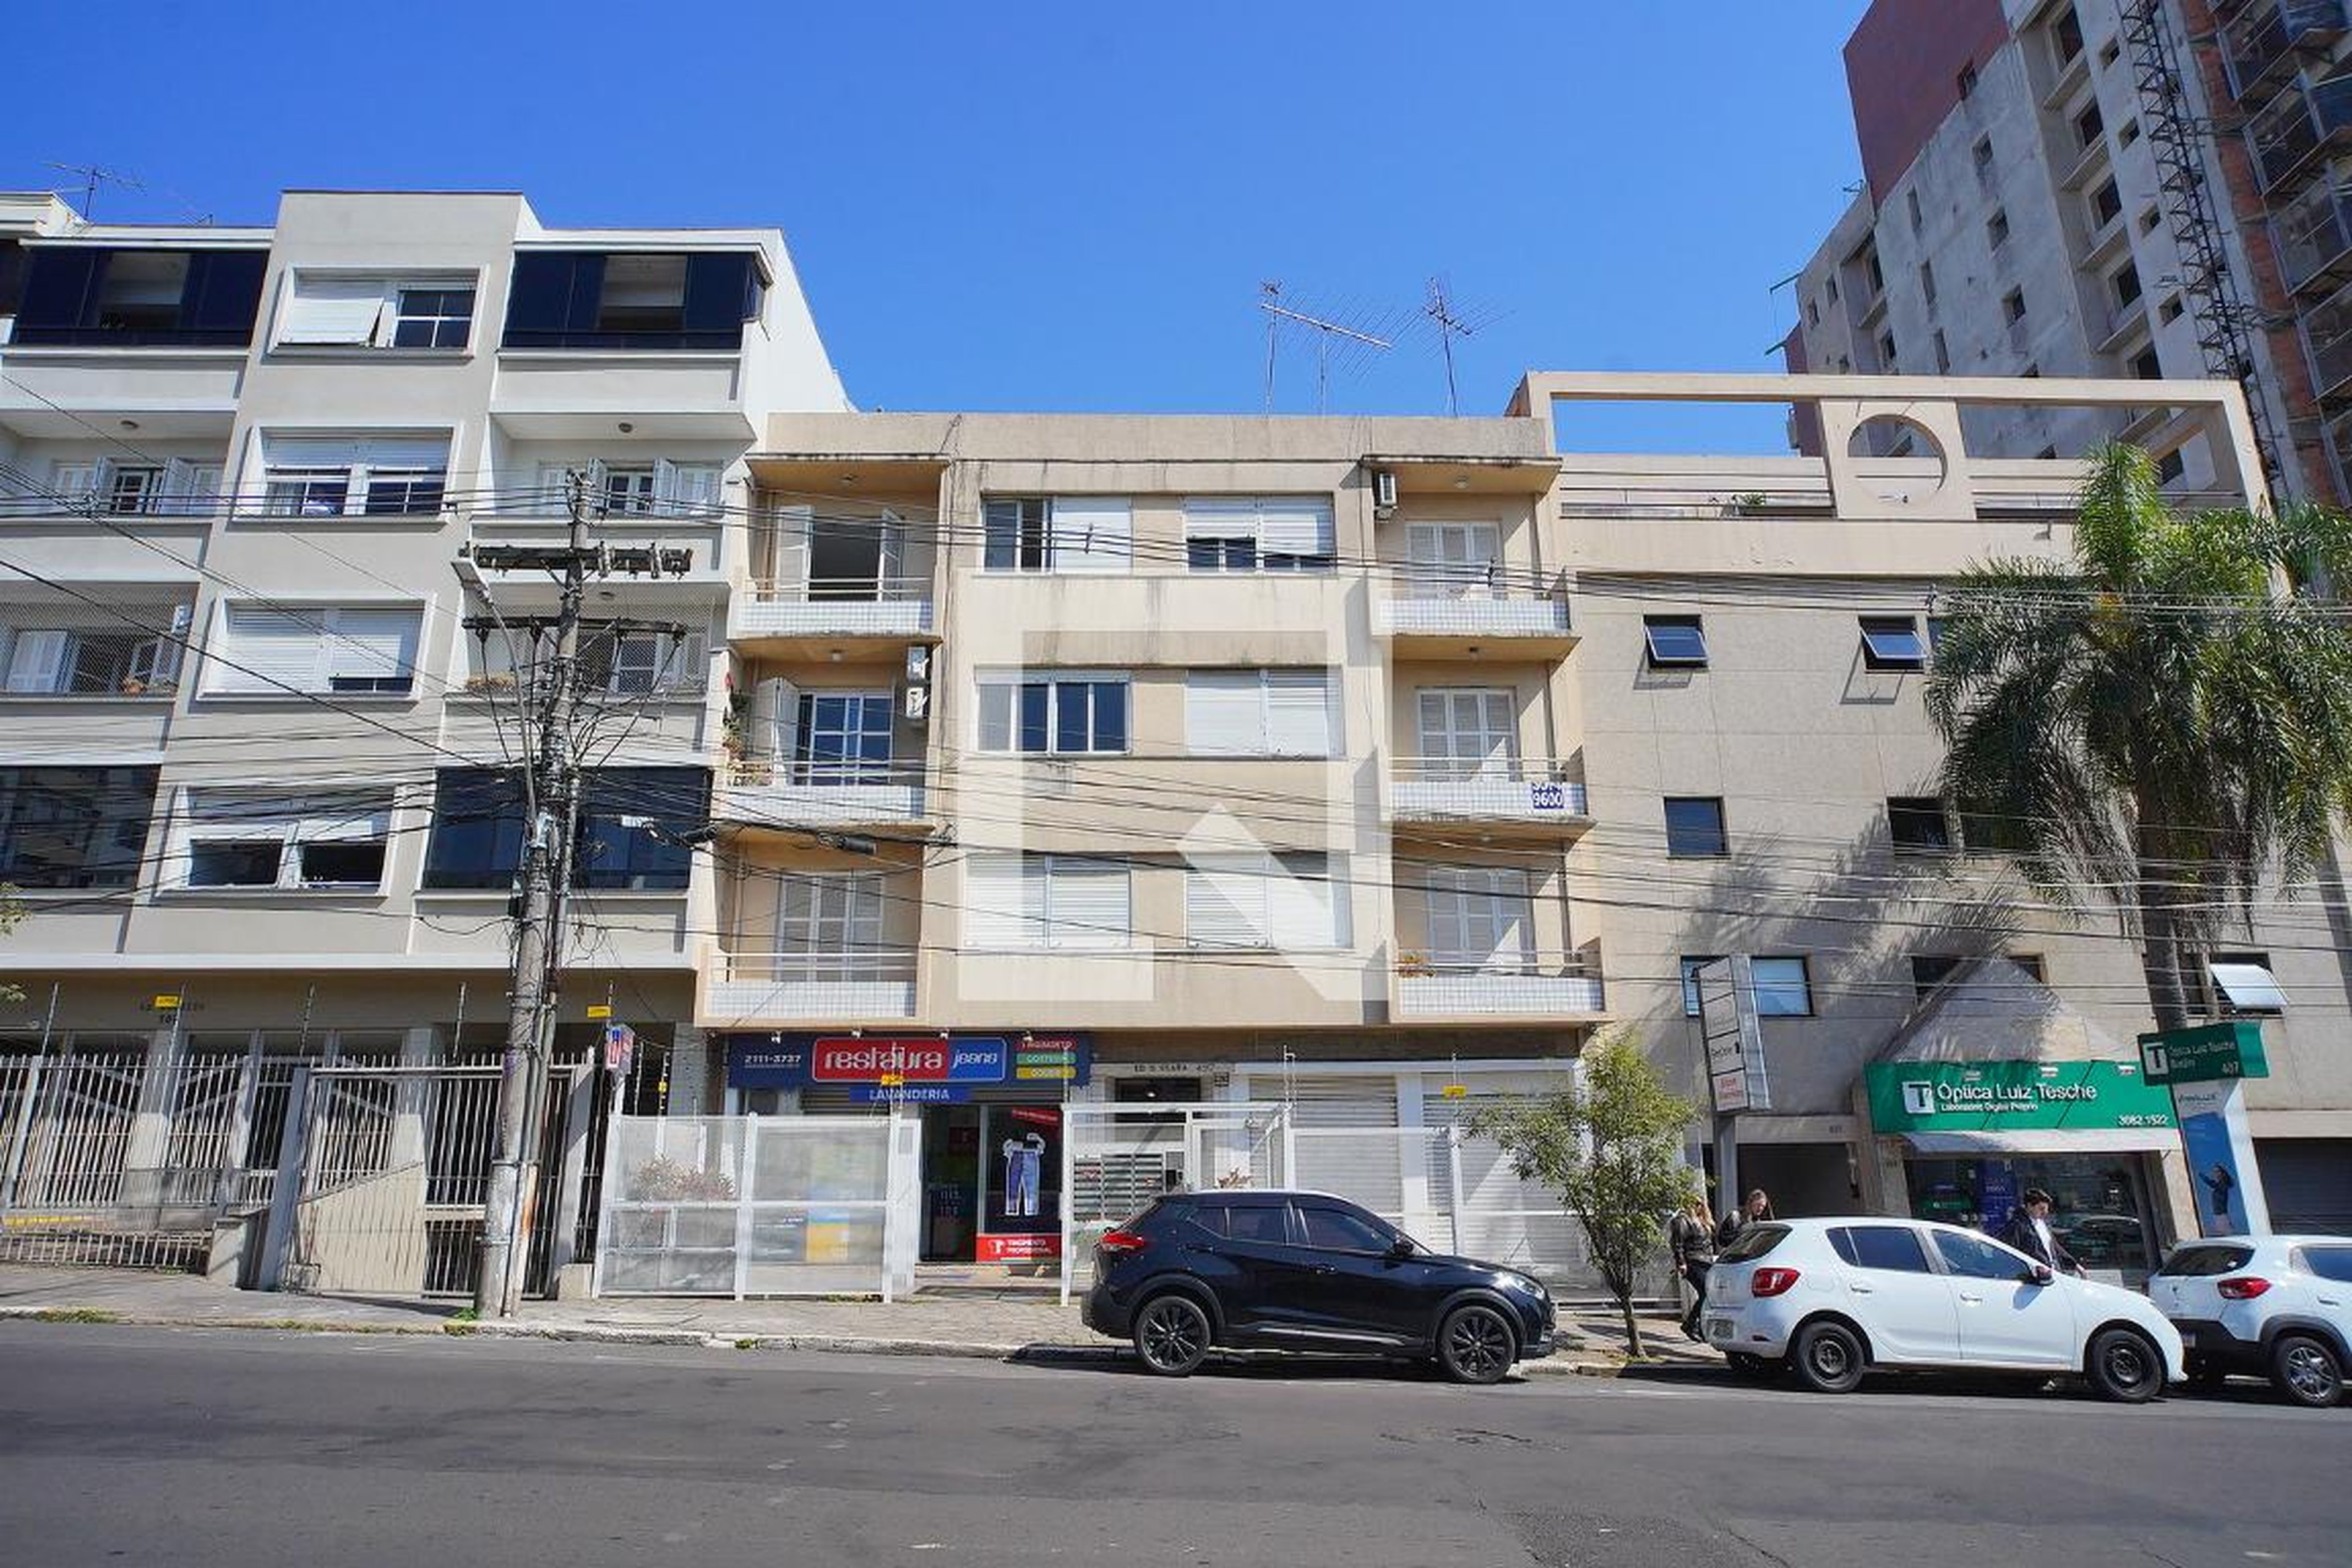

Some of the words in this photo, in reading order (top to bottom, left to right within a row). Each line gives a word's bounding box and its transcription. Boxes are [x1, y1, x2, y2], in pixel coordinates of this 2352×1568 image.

[826, 1046, 942, 1069] restaura
[953, 1050, 997, 1068] jeans
[869, 1088, 950, 1100] LAVANDERIA
[1937, 1080, 1992, 1103] Óptica
[1996, 1084, 2032, 1099] Luiz
[2036, 1082, 2097, 1099] Tesche
